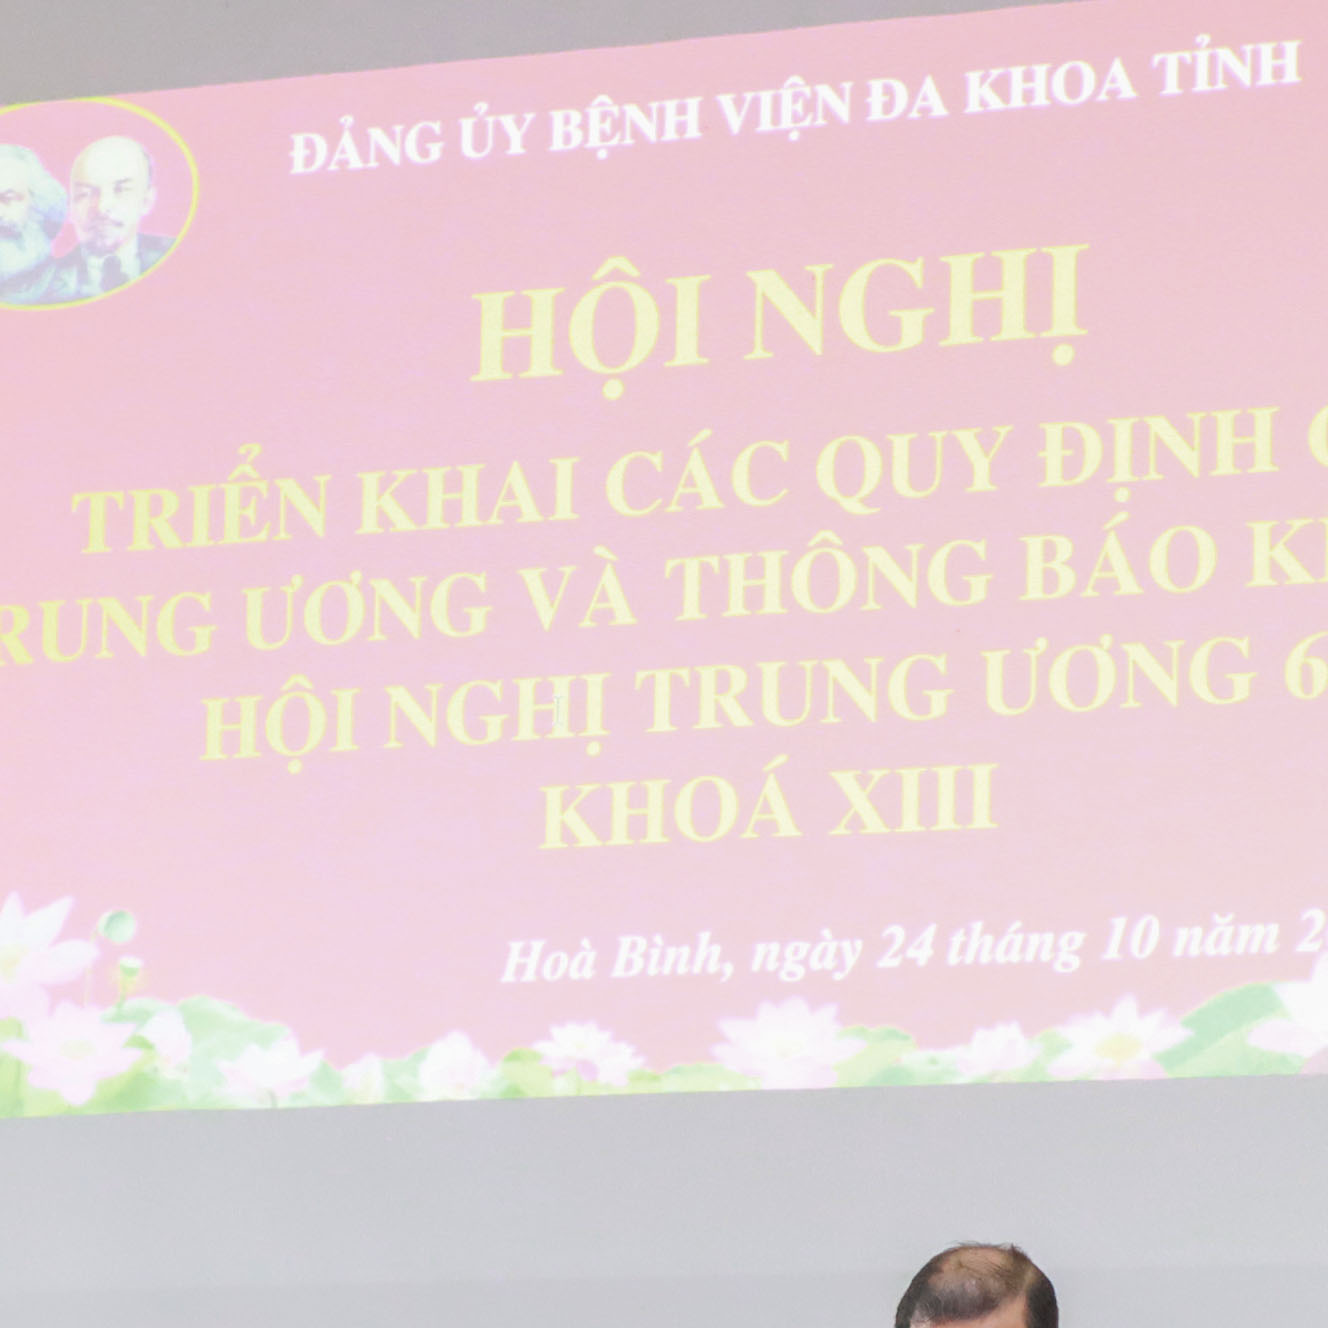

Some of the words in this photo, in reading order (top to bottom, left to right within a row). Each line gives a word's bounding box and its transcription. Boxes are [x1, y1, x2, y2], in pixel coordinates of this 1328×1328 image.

[289, 114, 445, 174] ĐẢNG
[459, 102, 535, 159] ỦY
[548, 94, 703, 160] BỆNH
[716, 75, 852, 141] VIỆN
[865, 75, 948, 121] ĐA
[964, 57, 1138, 114] KHOA
[1152, 33, 1303, 96] TỈNH
[470, 255, 711, 401] HỘI
[744, 243, 1090, 366] NGHỊ
[72, 442, 332, 554] TRIỂN
[355, 456, 580, 535] KHAI
[605, 428, 790, 518] CÁC
[815, 424, 1014, 515] QUY
[1038, 406, 1280, 503] ĐỊNH
[242, 570, 493, 652] ƯƠNG
[517, 545, 638, 632] VÀ
[665, 529, 993, 621] THÔNG
[1019, 511, 1217, 601] BÁO
[200, 674, 361, 774] HỘI
[384, 672, 612, 757] NGHỊ
[635, 653, 954, 733] TRUNG
[981, 634, 1257, 715] ƯƠNG
[537, 754, 802, 850] KHOÁ
[828, 763, 1000, 836] XIII
[500, 938, 597, 983] Hoà
[611, 929, 734, 983] Bình,
[751, 929, 863, 983] ngày
[877, 924, 937, 968] 24
[947, 920, 1087, 973] tháng
[1102, 914, 1159, 960] 10
[1173, 912, 1280, 957] năm
